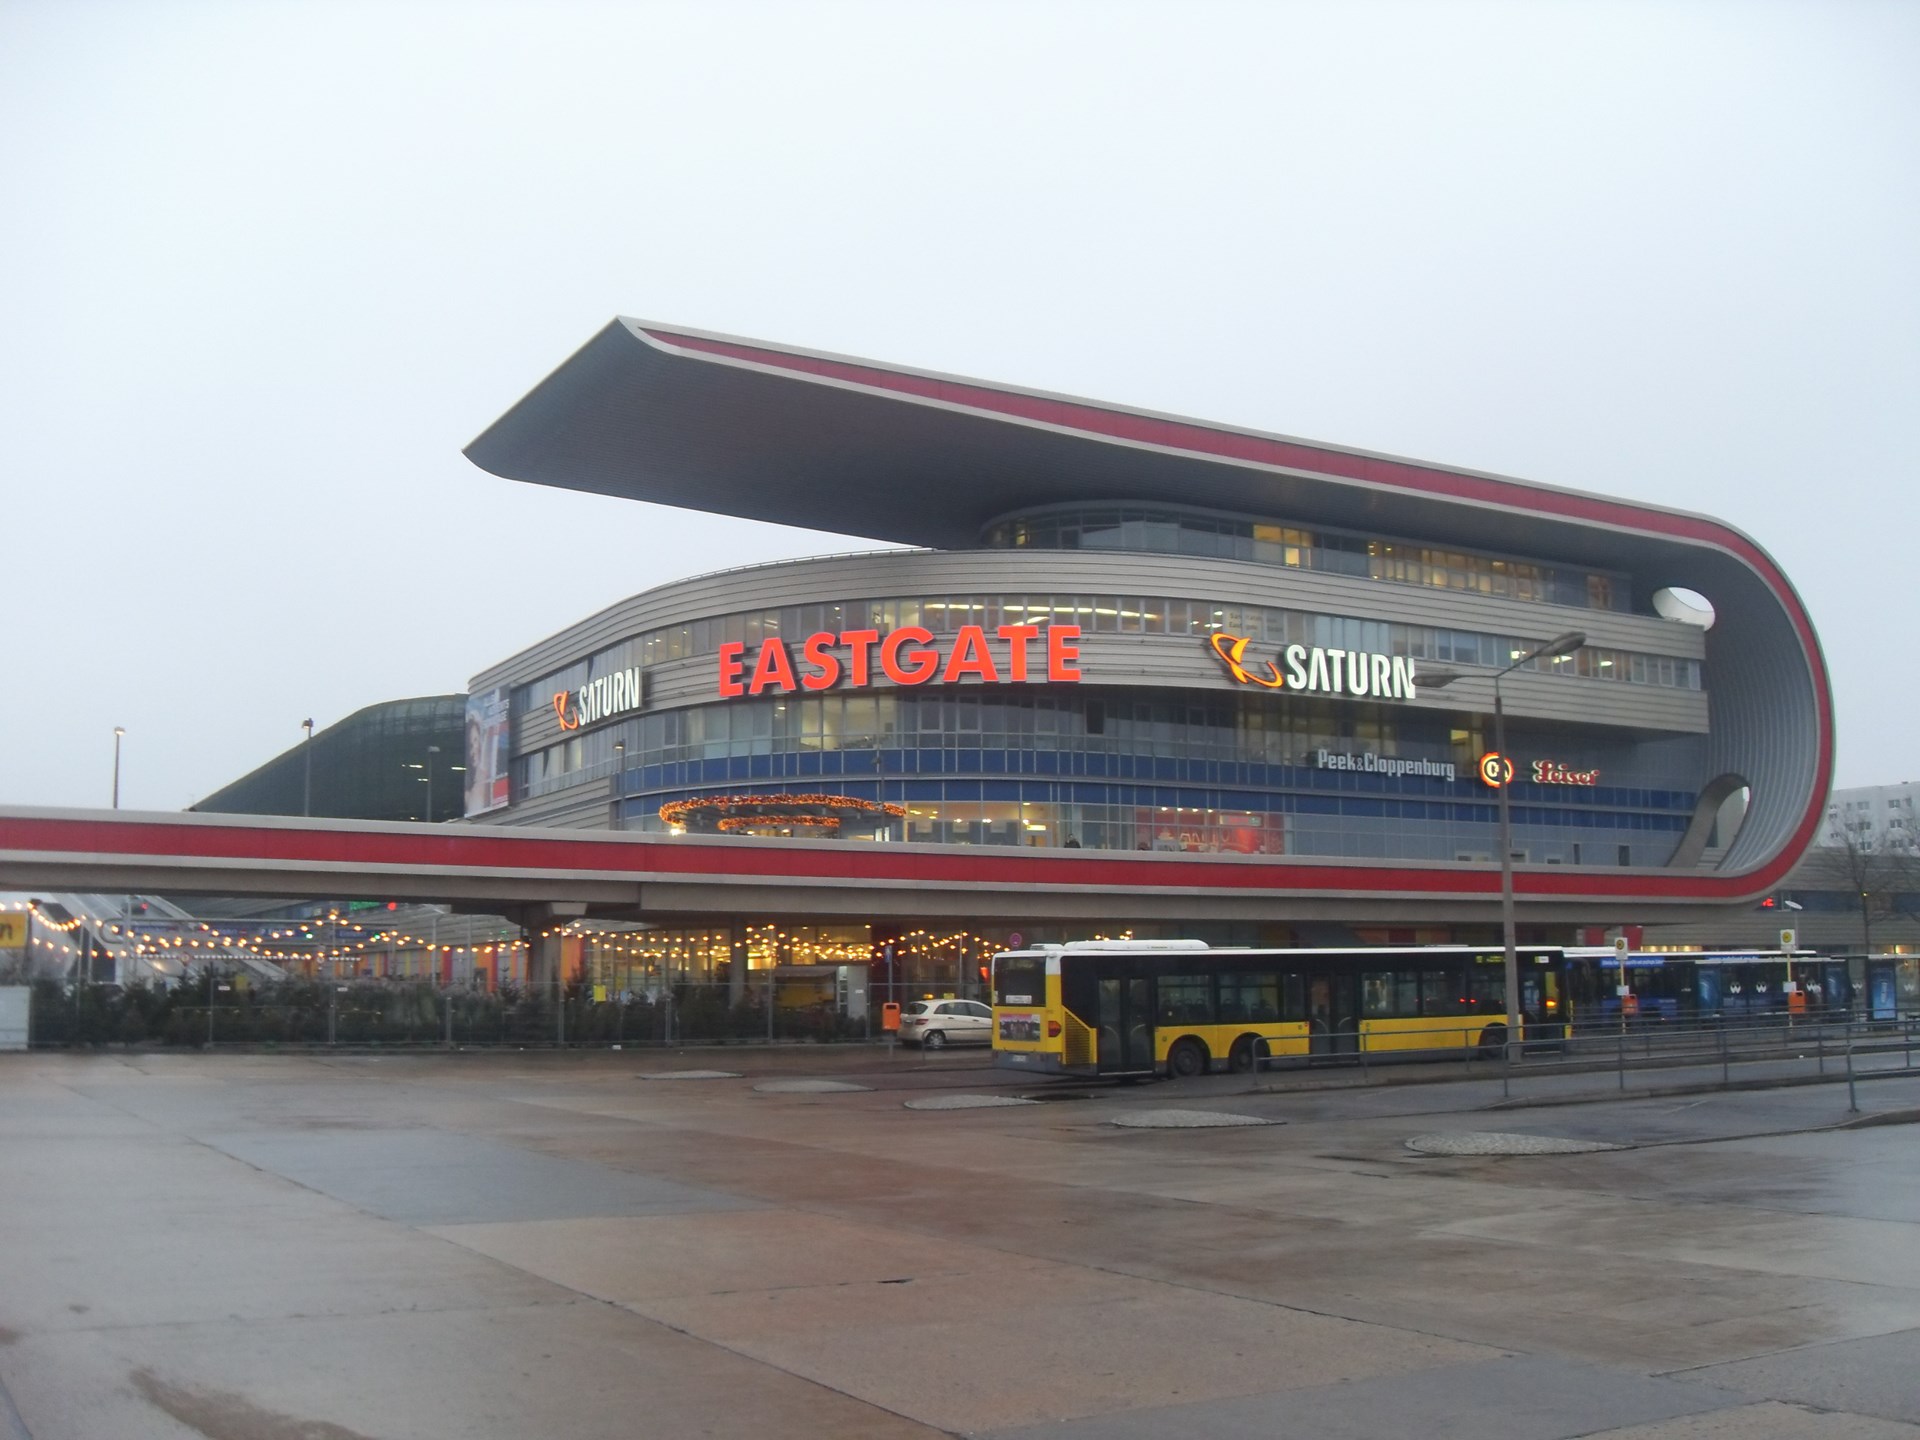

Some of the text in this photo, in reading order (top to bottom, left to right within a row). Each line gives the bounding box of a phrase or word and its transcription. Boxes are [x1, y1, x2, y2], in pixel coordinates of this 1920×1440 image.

[719, 625, 1081, 697] EASTGATE
[1286, 644, 1416, 699] SATURN
[579, 666, 639, 726] SATURN
[1532, 759, 1600, 786] Leiser
